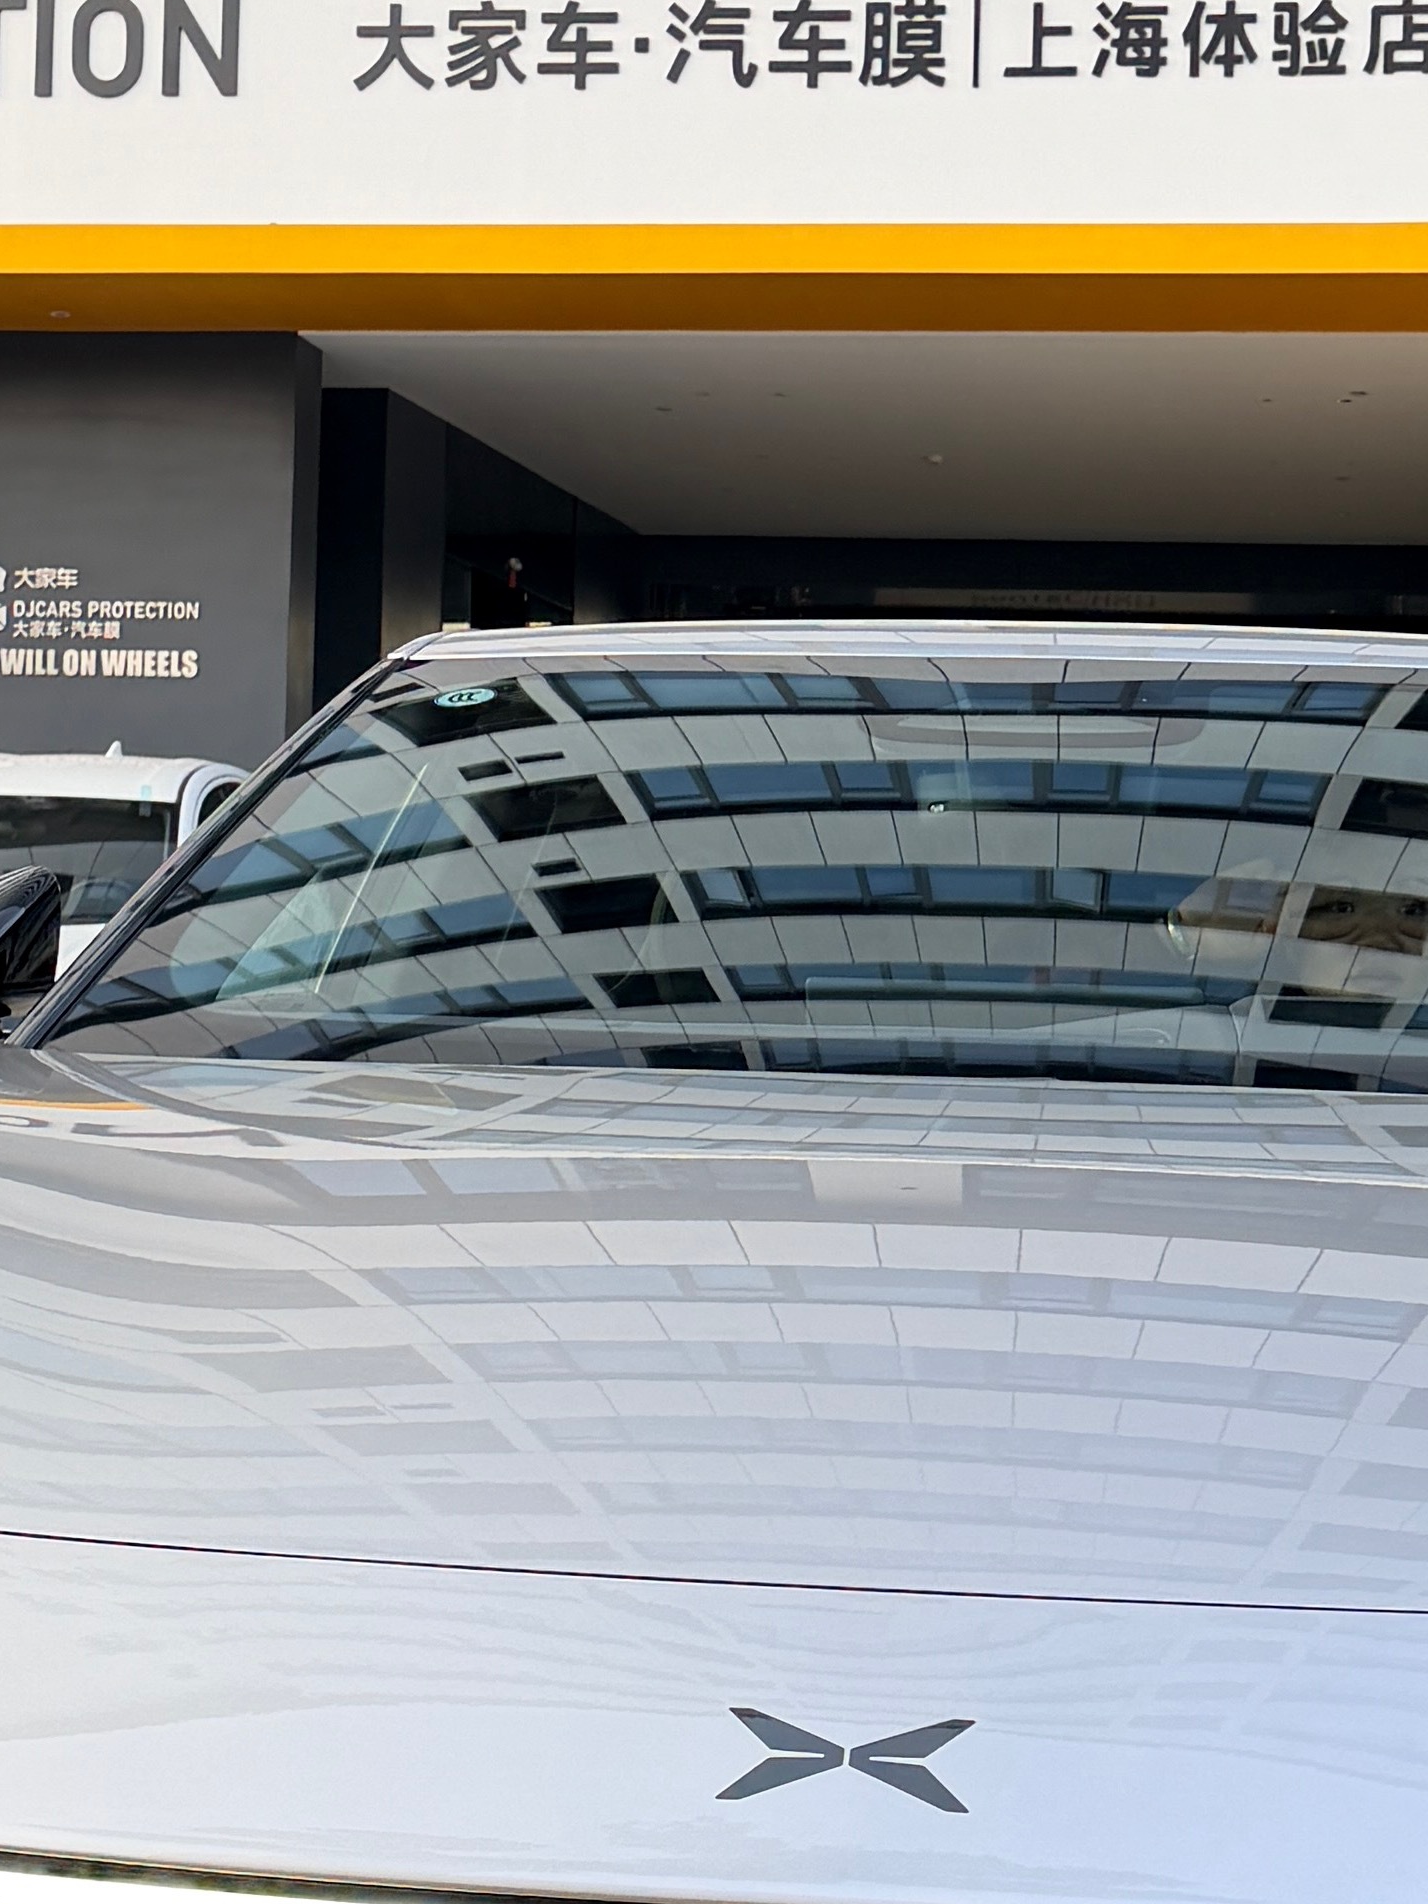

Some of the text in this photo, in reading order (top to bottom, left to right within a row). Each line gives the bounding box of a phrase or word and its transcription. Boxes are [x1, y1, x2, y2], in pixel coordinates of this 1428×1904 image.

[13, 567, 78, 589] 大家车
[12, 600, 200, 620] DJCARS PROTECTION
[0, 648, 198, 678] WILL ON WHEELS
